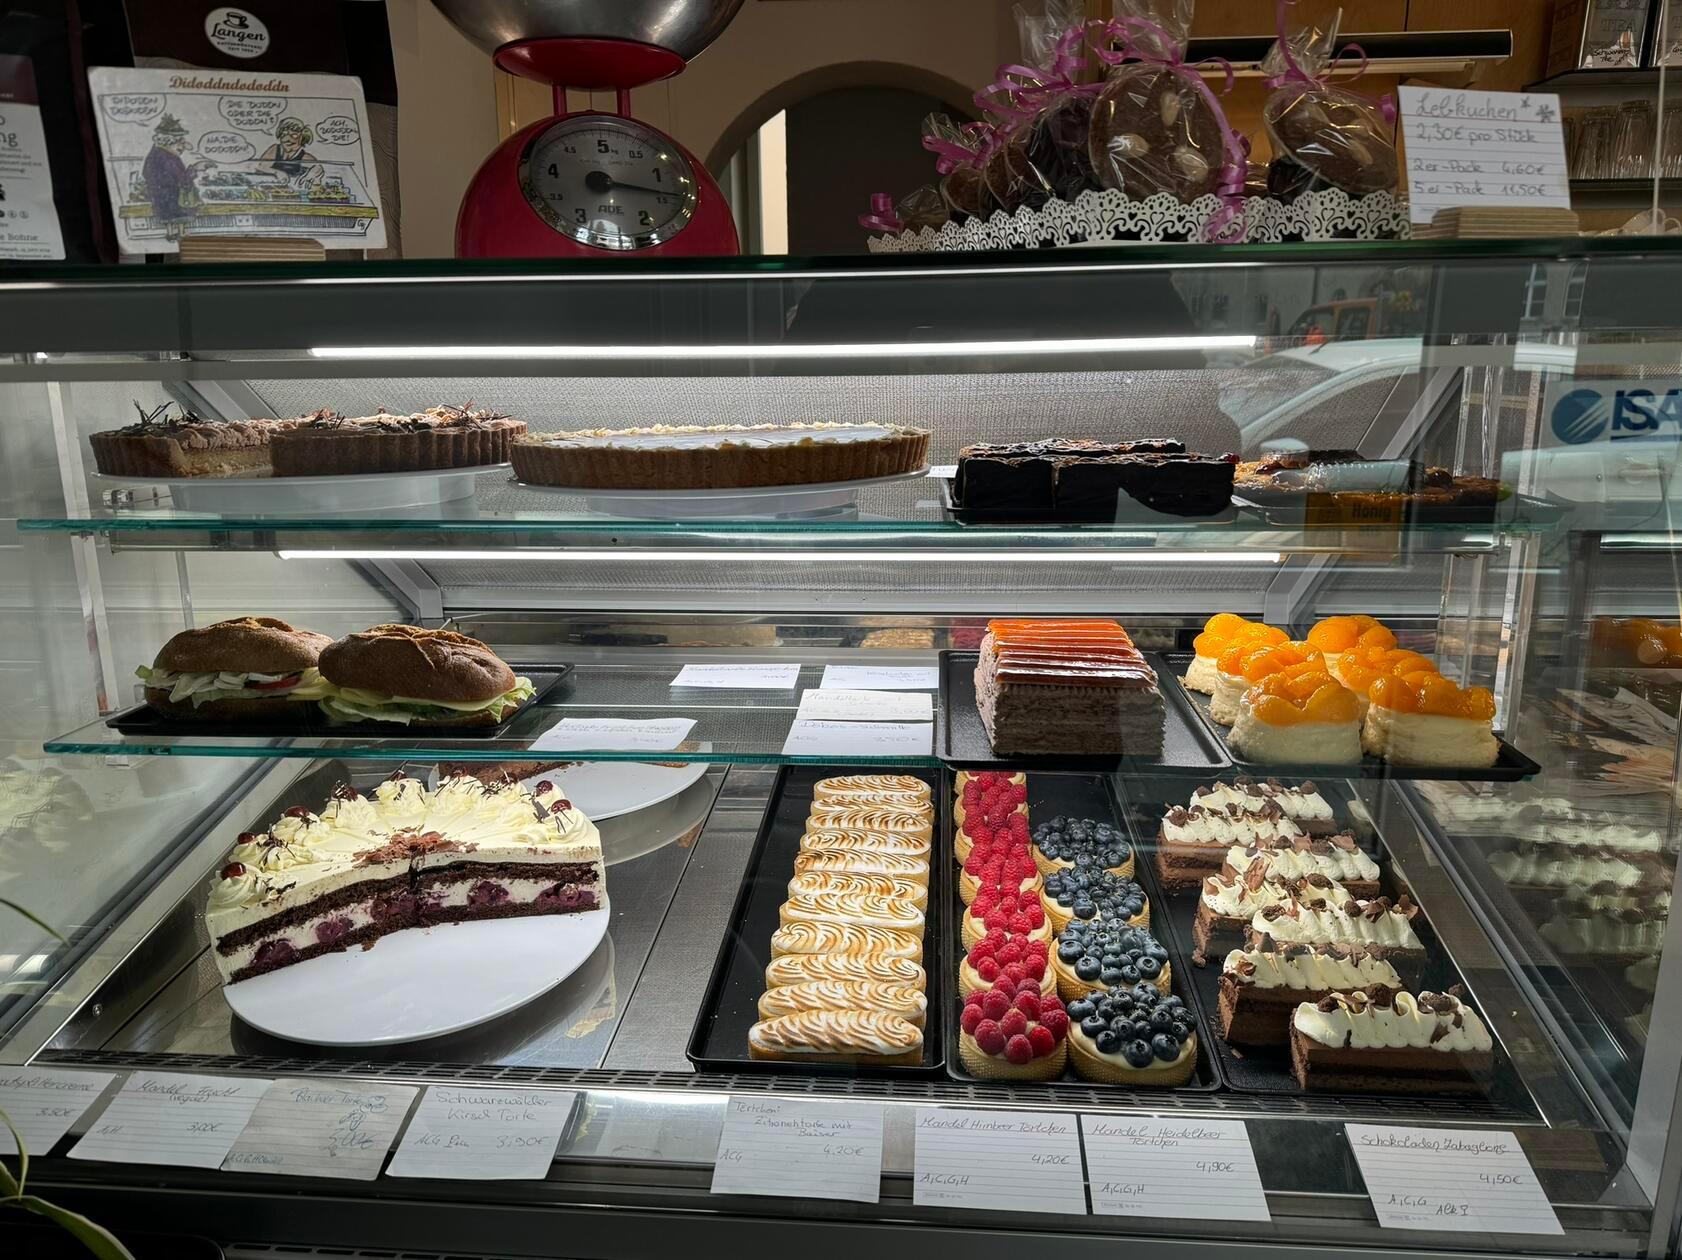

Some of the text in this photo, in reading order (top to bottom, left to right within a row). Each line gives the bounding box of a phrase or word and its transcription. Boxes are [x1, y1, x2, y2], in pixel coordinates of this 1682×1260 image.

[210, 23, 266, 42] Langen
[226, 100, 243, 109] DIE
[1415, 93, 1517, 122] Lebkuchen
[1416, 123, 1536, 146] 2,30€ pro Stück
[564, 146, 576, 154] 4.5
[597, 140, 610, 154] 5
[629, 150, 643, 159] 0.5
[548, 163, 661, 182] 4 1
[575, 208, 650, 226] 3 2
[598, 205, 624, 215] ADE
[1612, 389, 1682, 431] ISA
[435, 1091, 552, 1105] Schwarzwälder
[498, 1109, 537, 1121] Torte
[831, 1121, 853, 1130] mit
[920, 1116, 968, 1129] Mandel
[1091, 1123, 1148, 1137] Mandel
[1360, 1131, 1440, 1153] Schokoladen
[1031, 1153, 1071, 1165] 4,20€
[1195, 1160, 1235, 1173] 4,90€
[1479, 1173, 1523, 1185] 4,50€
